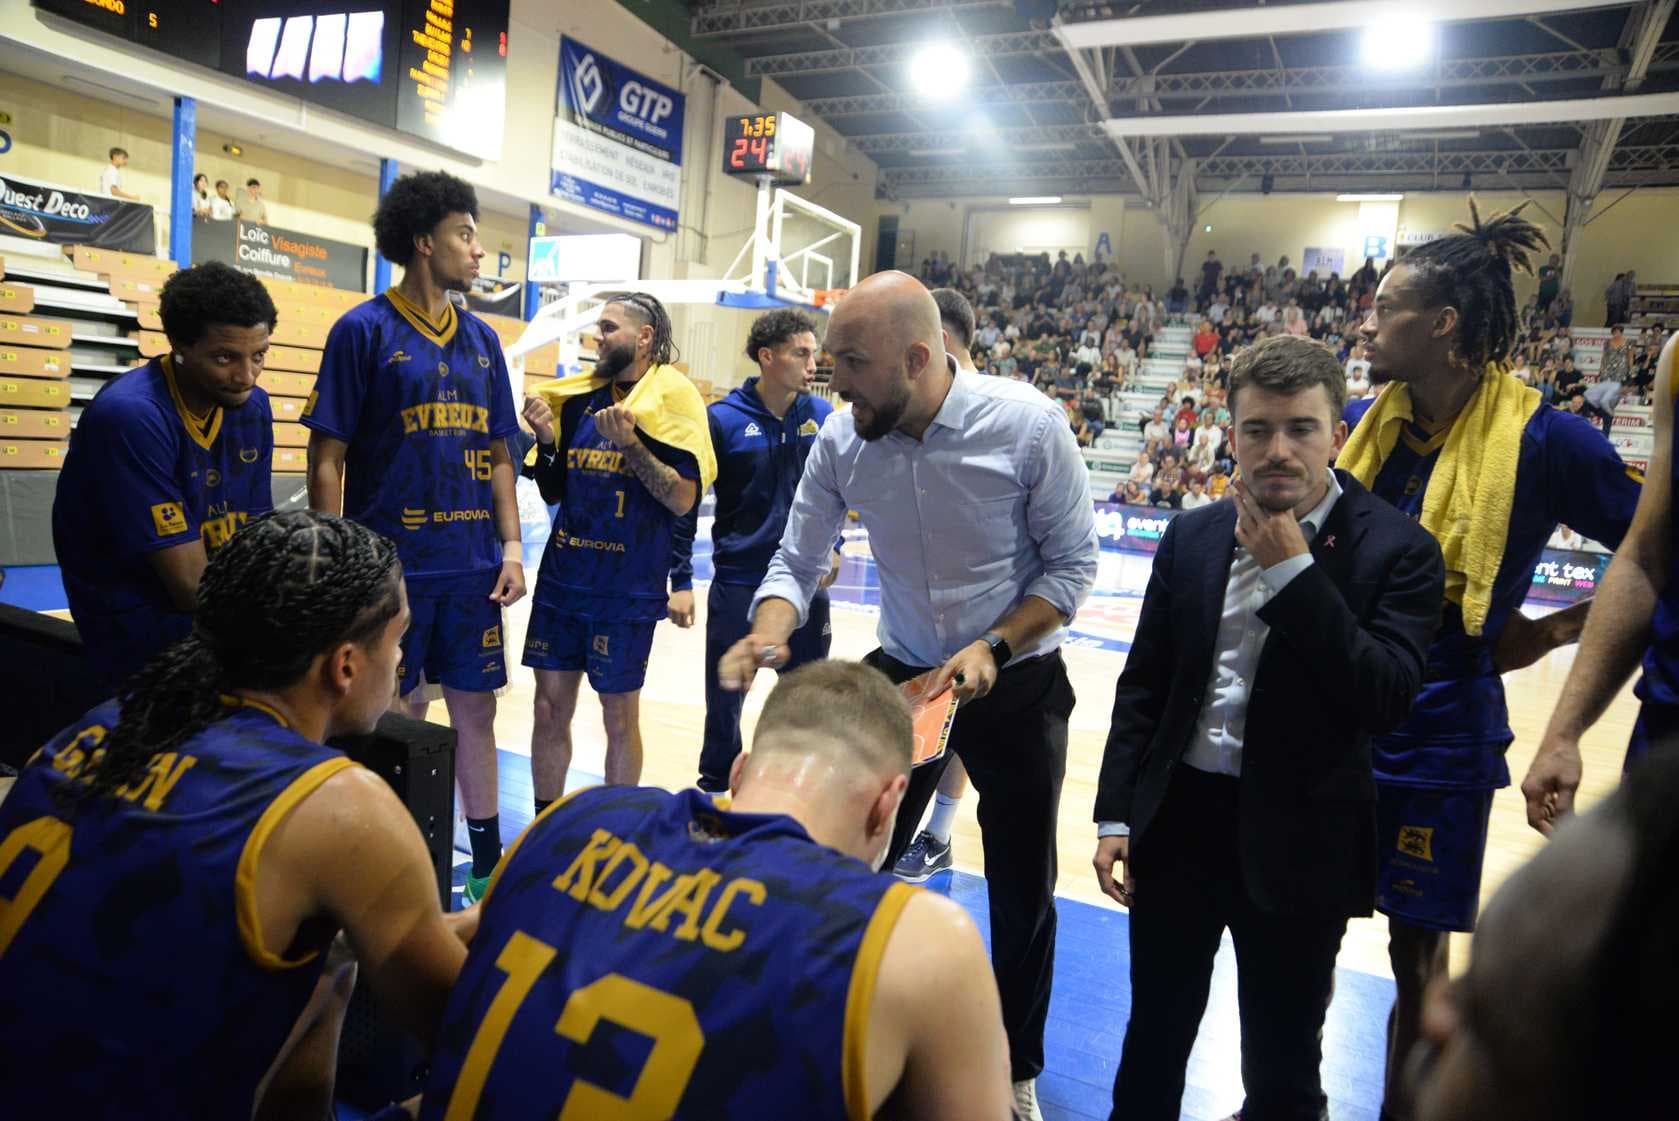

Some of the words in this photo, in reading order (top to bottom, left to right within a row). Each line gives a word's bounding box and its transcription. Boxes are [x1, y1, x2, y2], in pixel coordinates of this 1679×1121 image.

[619, 80, 674, 125] GTP
[730, 138, 767, 167] 24
[44, 191, 89, 220] Deco
[238, 245, 291, 268] Coiffure
[1364, 235, 1387, 258] B
[437, 389, 458, 401] ALM
[401, 402, 489, 434] EVREUX
[464, 449, 493, 481] 45
[566, 447, 626, 474] EVREU
[433, 510, 490, 523] EUROVIA
[613, 490, 625, 518] 1
[569, 536, 626, 553] EUROVIA
[552, 828, 768, 952] KOVAC
